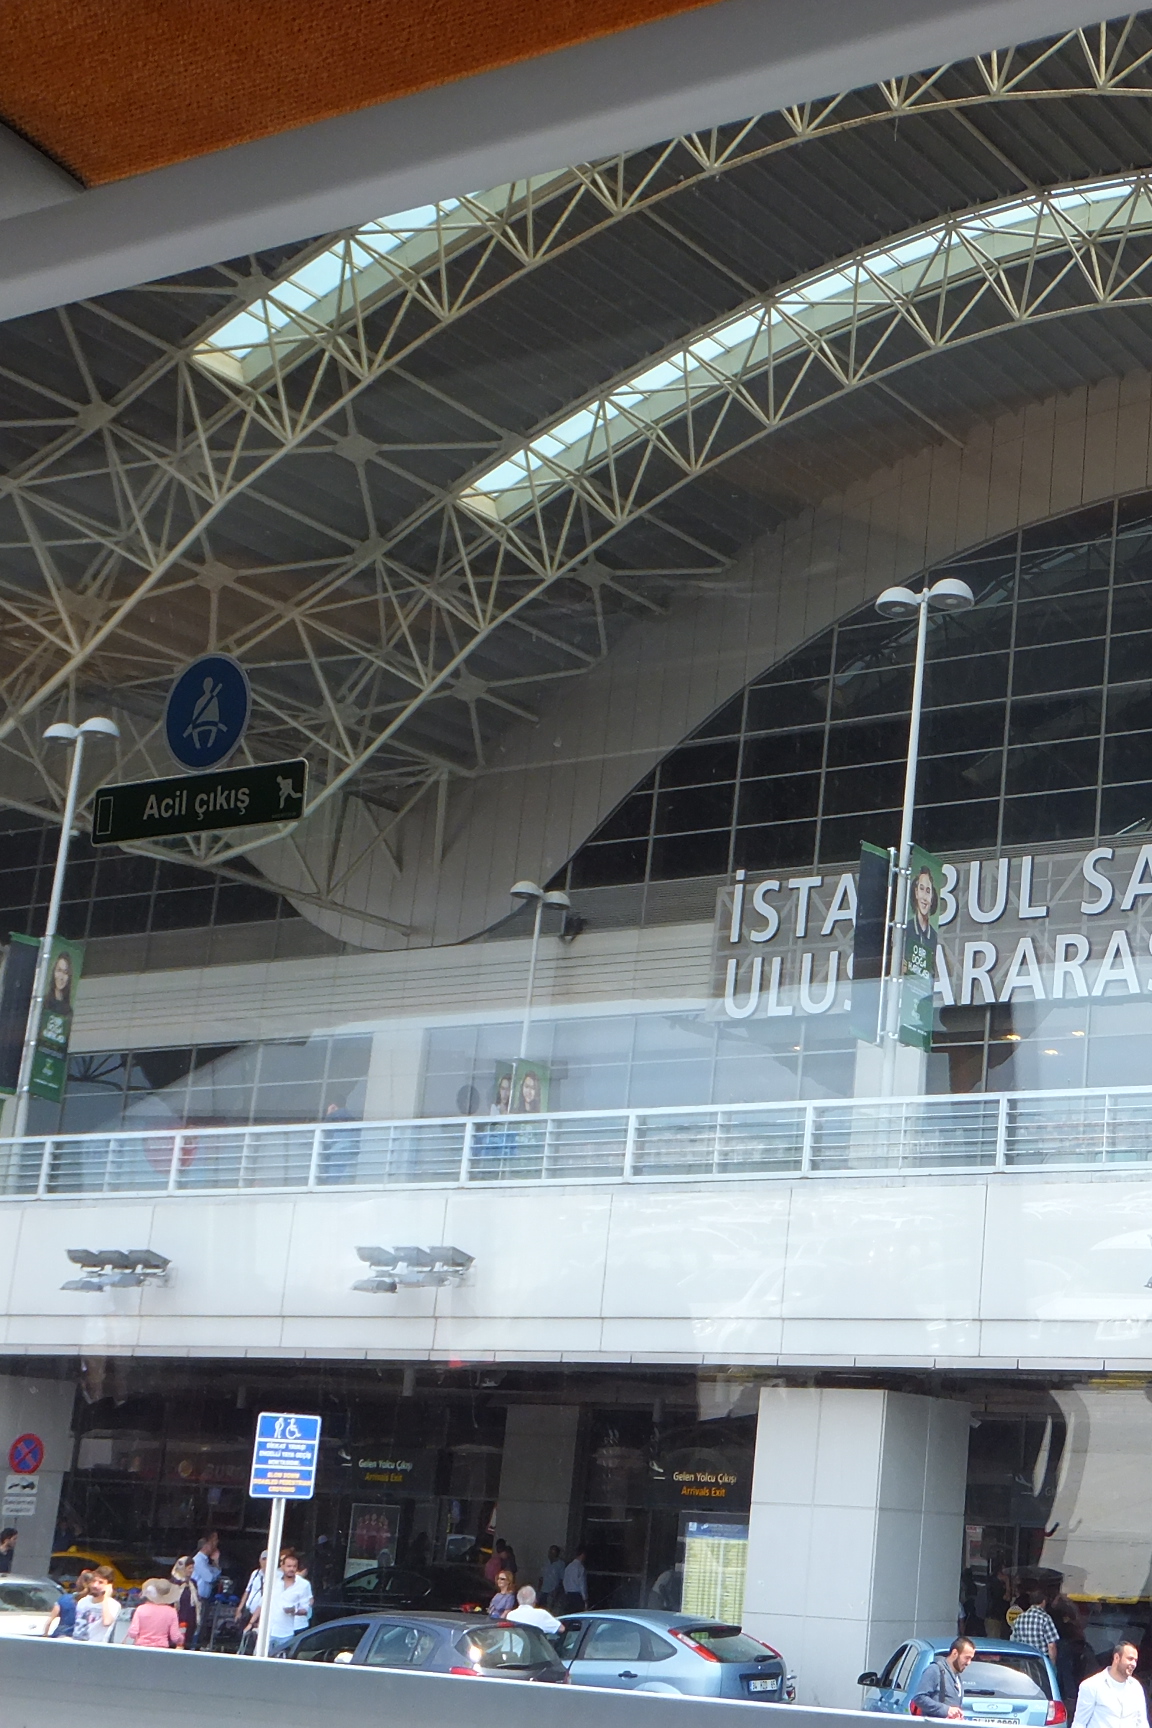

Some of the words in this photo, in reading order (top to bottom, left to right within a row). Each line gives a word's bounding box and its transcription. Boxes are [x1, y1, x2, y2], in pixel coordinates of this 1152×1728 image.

[143, 790, 188, 820] Acil
[194, 785, 250, 820] çıkış
[729, 855, 1048, 943] İSTABUL
[673, 1472, 695, 1482] Gelen
[696, 1473, 716, 1483] Yolcu
[717, 1473, 737, 1485] Çıkışı
[681, 1486, 710, 1496] Arrivals
[711, 1487, 726, 1497] Exit
